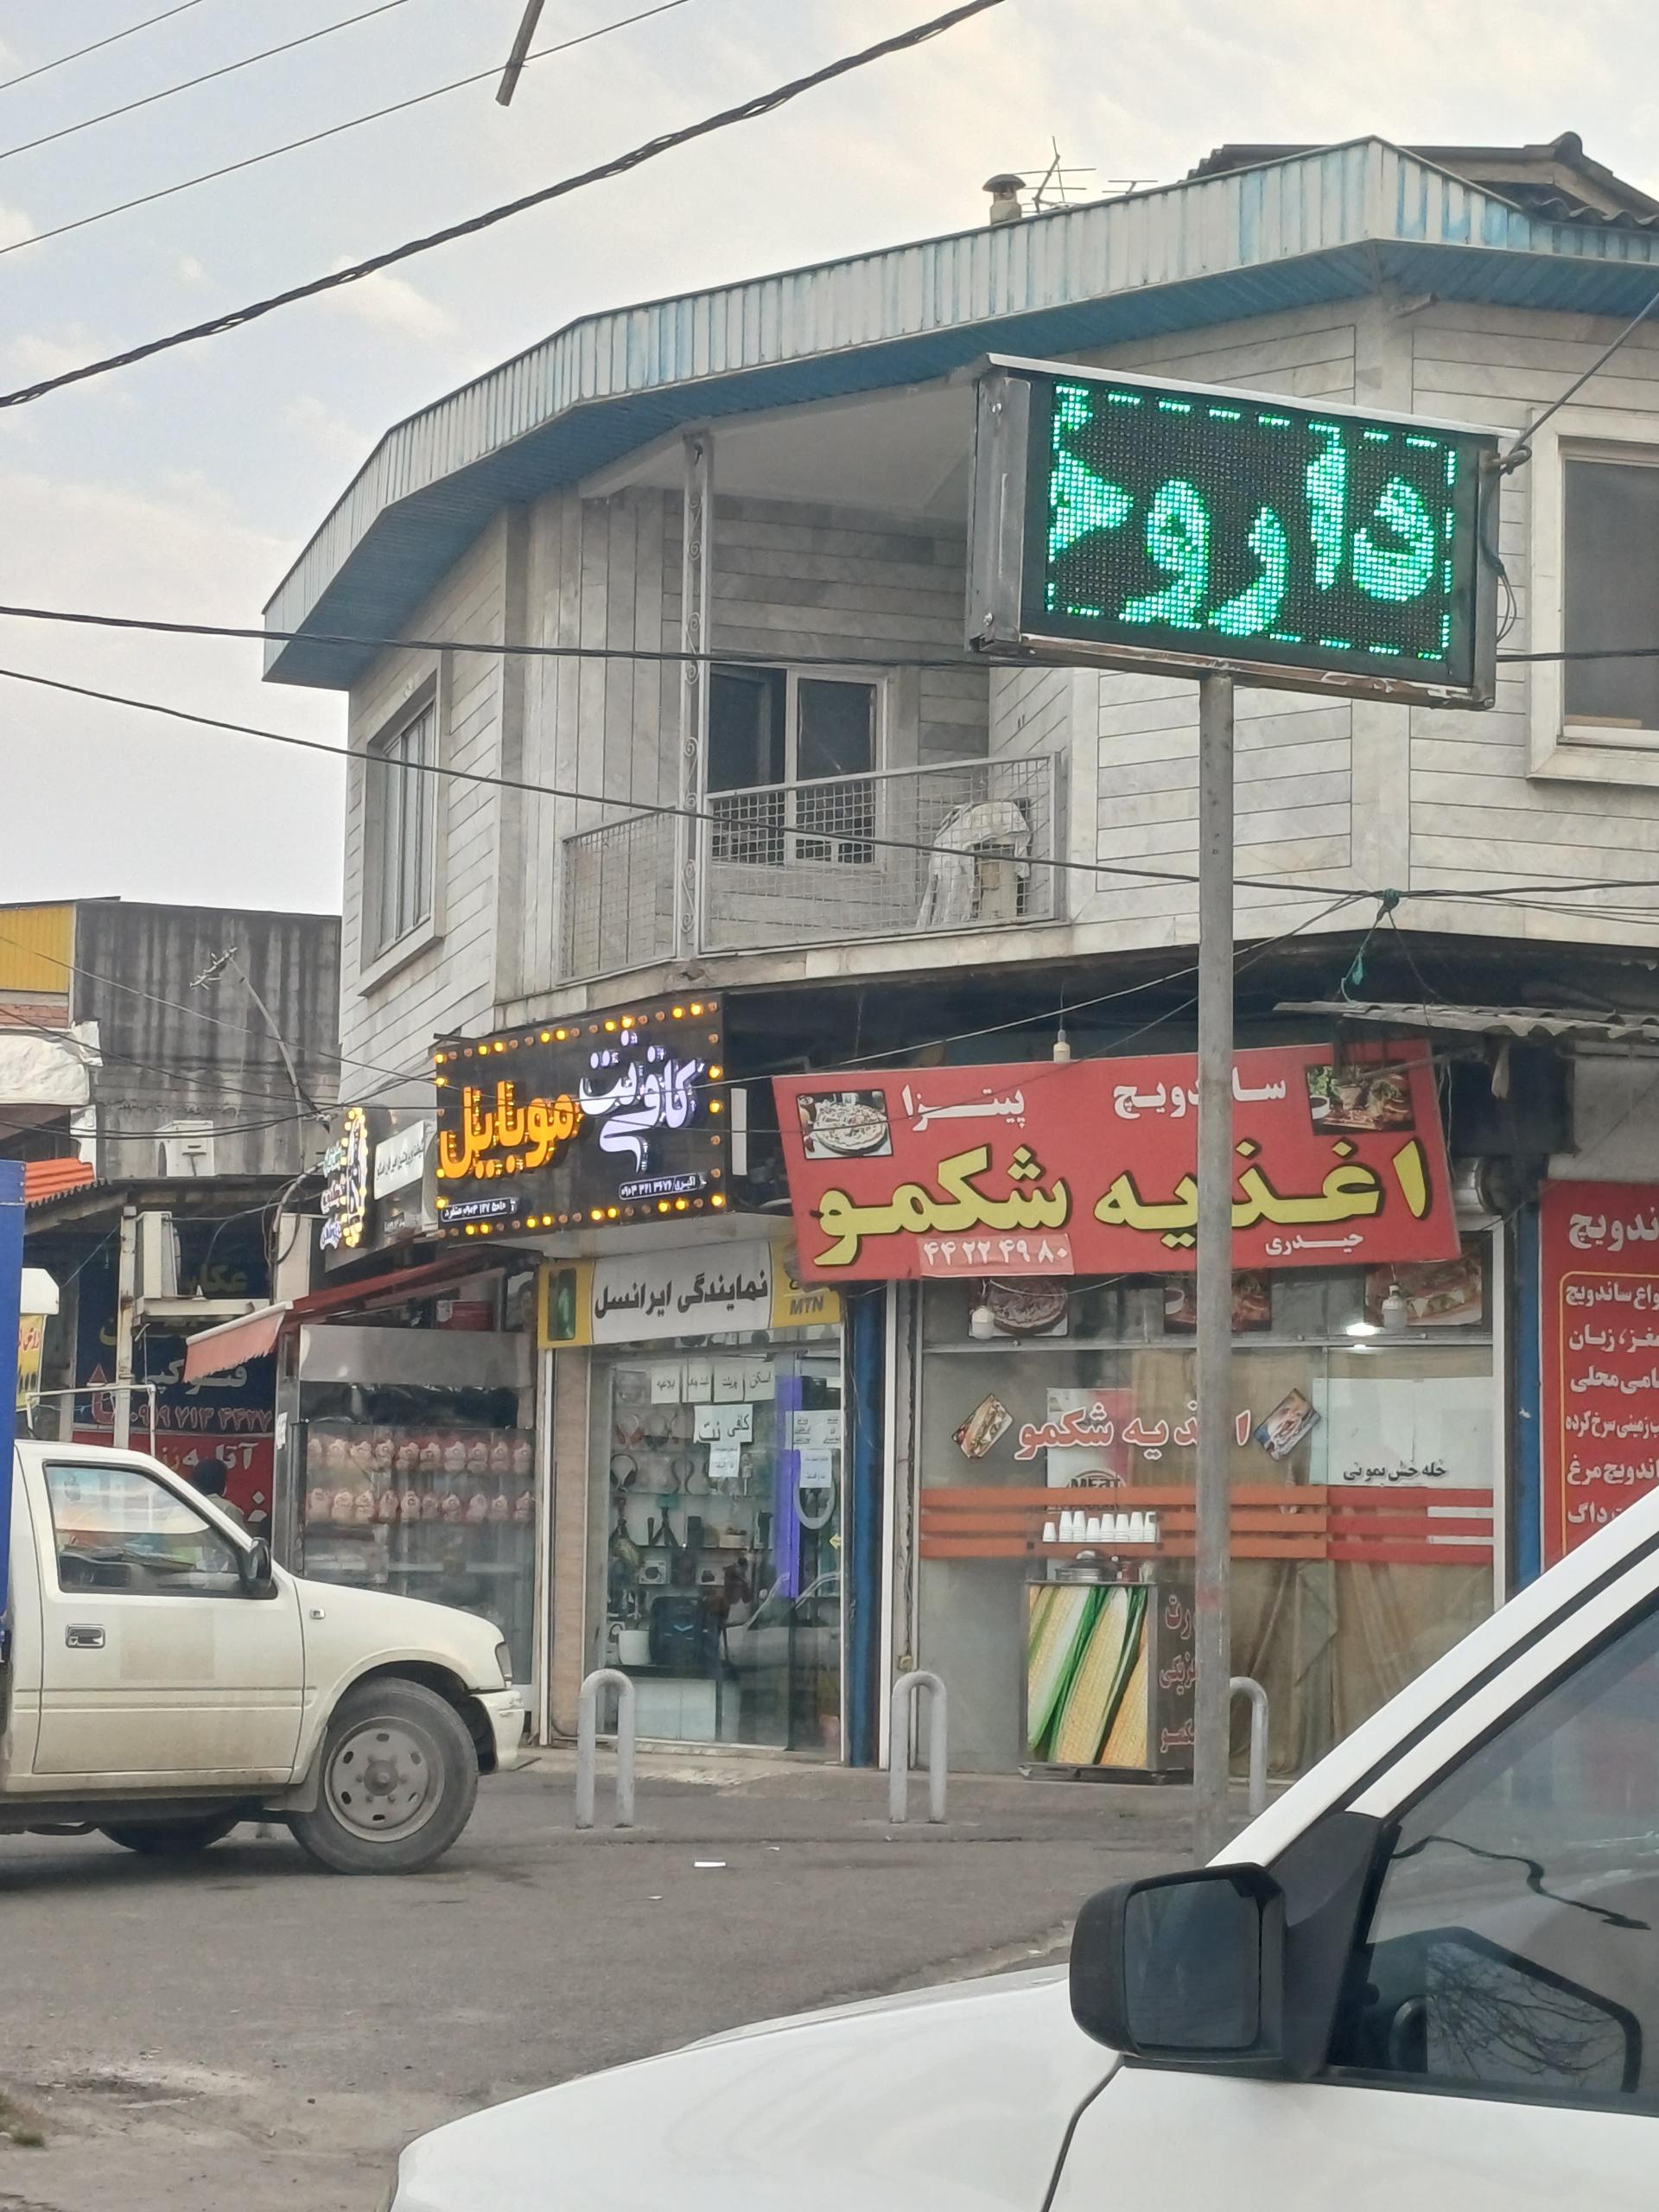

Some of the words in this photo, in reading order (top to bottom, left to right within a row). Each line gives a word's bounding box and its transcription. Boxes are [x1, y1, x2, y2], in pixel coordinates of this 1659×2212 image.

[901, 1084, 1026, 1131] پیتزا
[1113, 1066, 1286, 1120] سادویچ
[440, 1080, 575, 1179] موبایل
[813, 1146, 1068, 1266] شکمو
[1094, 1140, 1426, 1249] اغذیه
[1265, 1233, 1363, 1255] حیدری
[595, 1281, 672, 1319] ایرانسل
[677, 1269, 768, 1313] نمایندگی
[789, 1298, 823, 1316] MTN
[1566, 1281, 1631, 1307] ساندویچ
[1569, 1324, 1615, 1352] زبان
[1570, 1364, 1619, 1393] محلی
[699, 1421, 721, 1441] نت
[1014, 1402, 1114, 1460] شکمو
[1122, 1400, 1251, 1460] اذیه
[1567, 1453, 1602, 1485] مرغ
